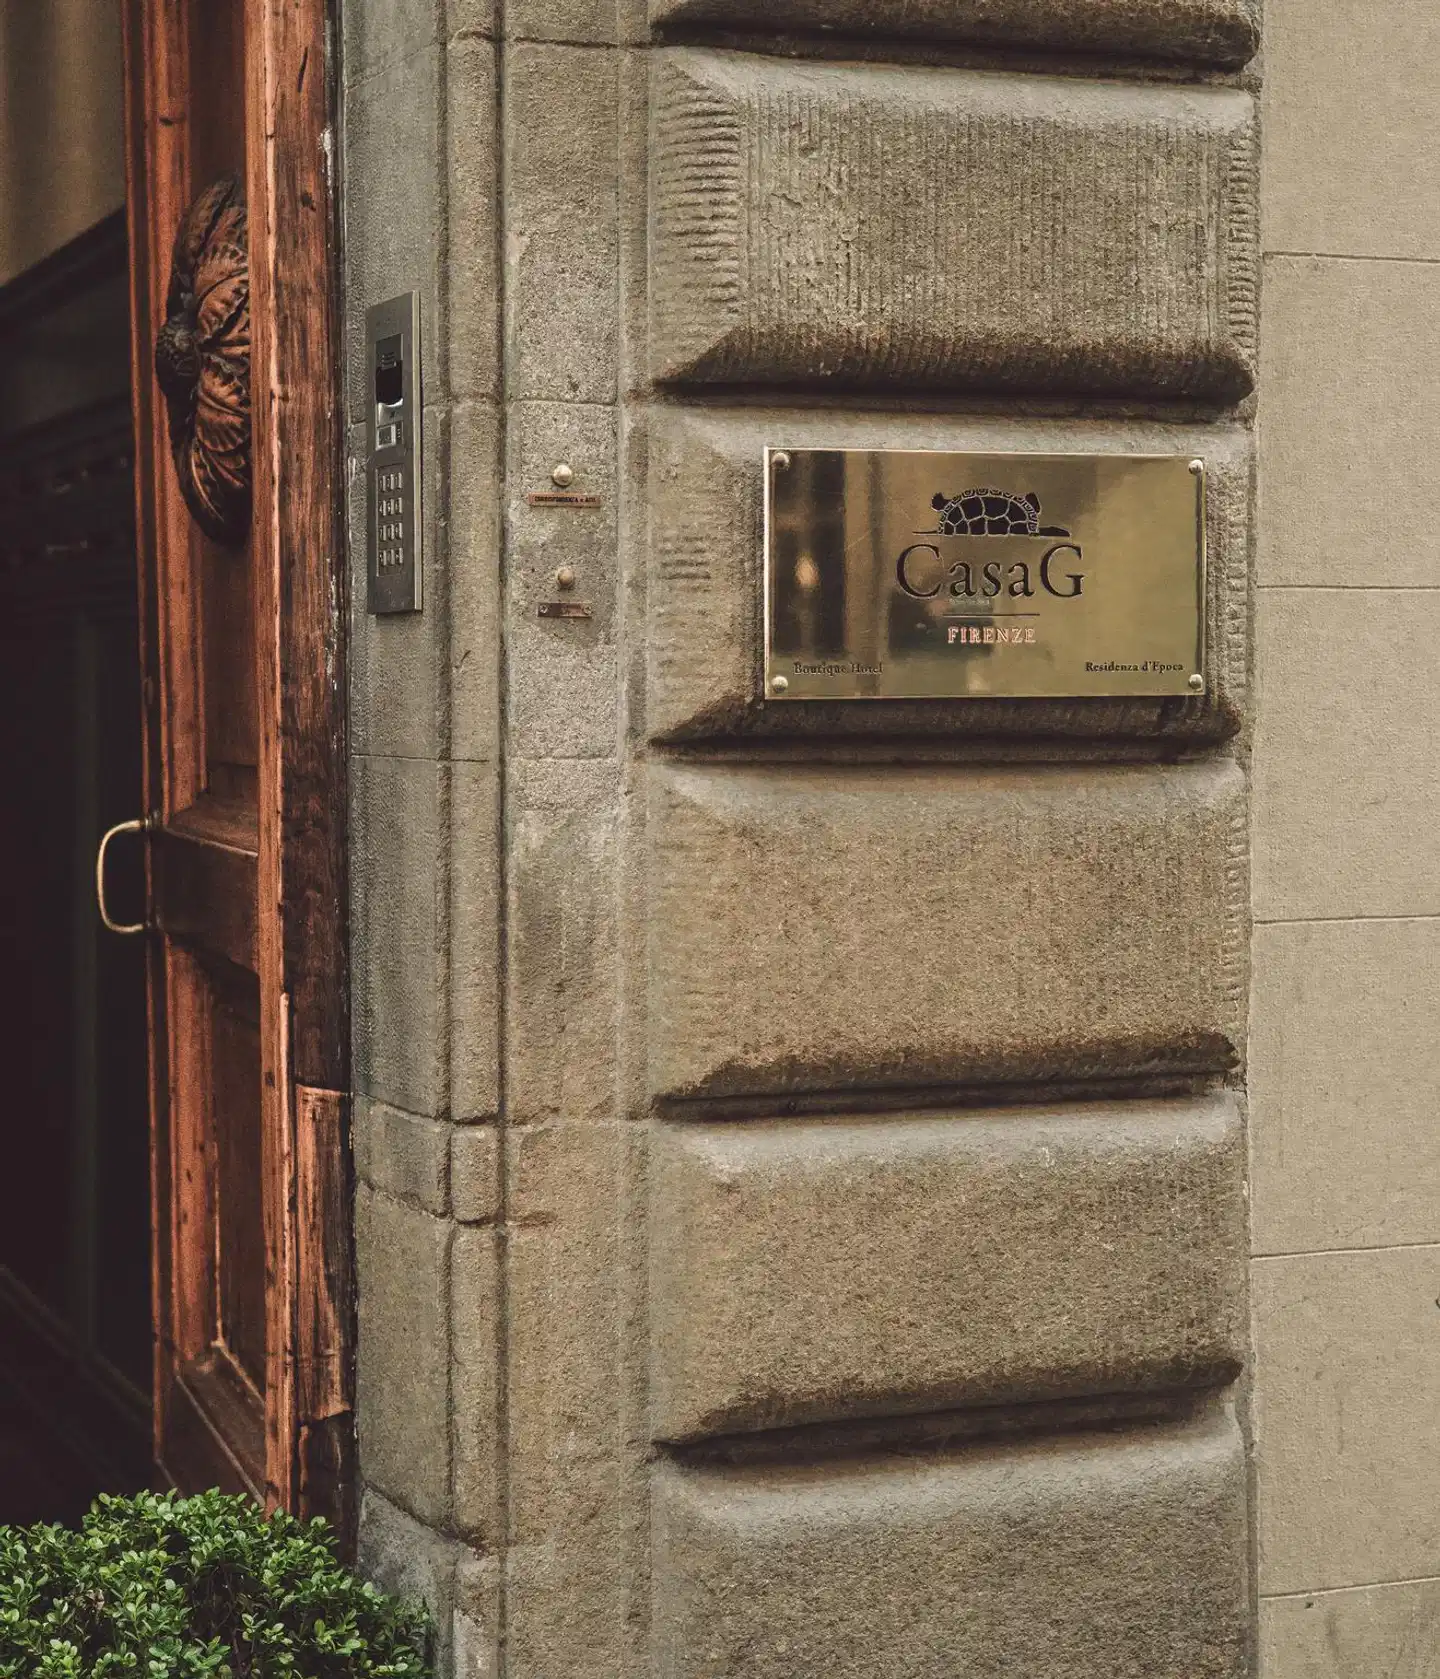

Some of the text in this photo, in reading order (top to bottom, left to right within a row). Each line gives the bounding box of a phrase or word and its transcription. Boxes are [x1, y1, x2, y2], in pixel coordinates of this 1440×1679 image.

[896, 543, 1085, 598] CasaG
[947, 626, 1037, 644] FIRENZE
[794, 661, 884, 677] Boutique Hotel
[1085, 660, 1184, 674] Residenza d'Epoca
